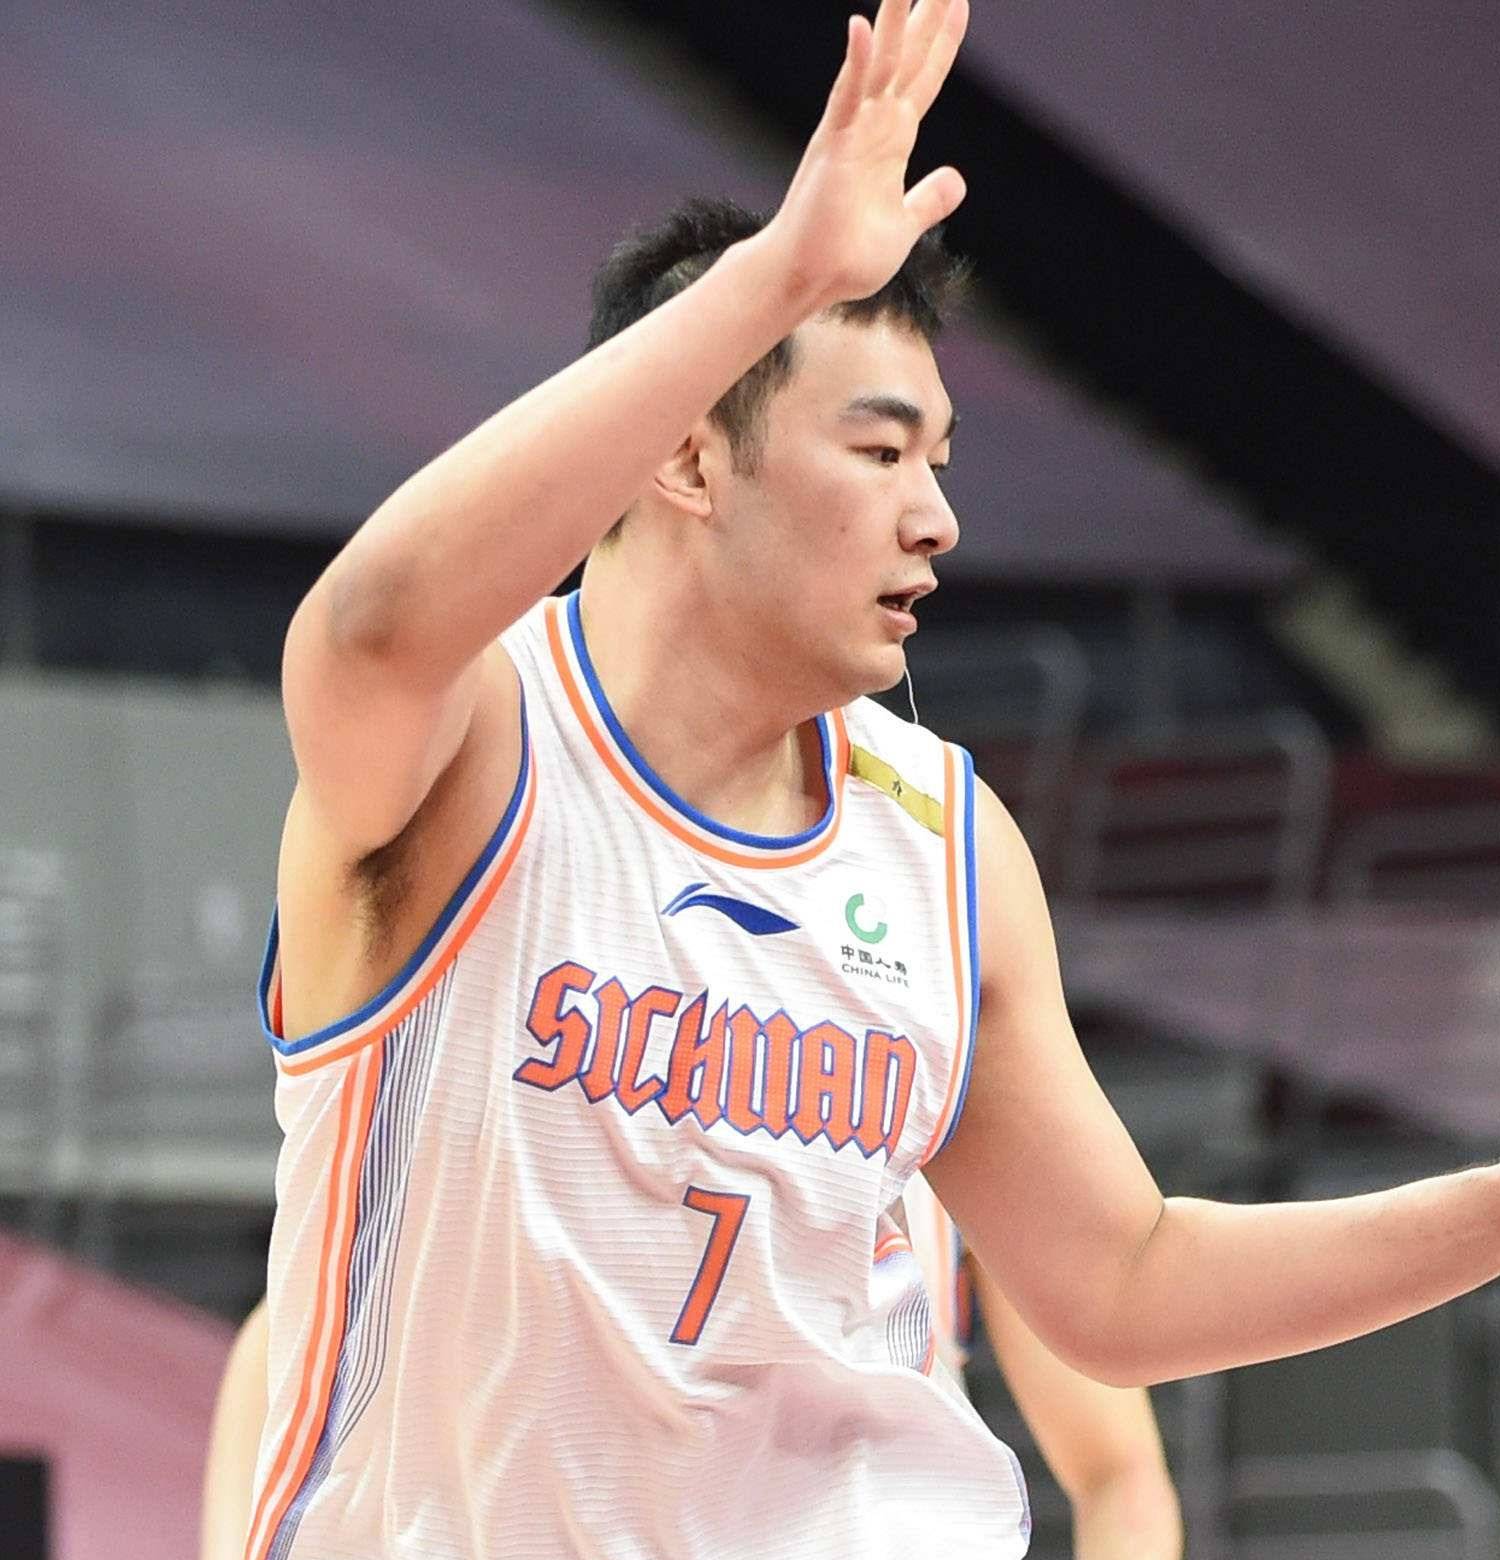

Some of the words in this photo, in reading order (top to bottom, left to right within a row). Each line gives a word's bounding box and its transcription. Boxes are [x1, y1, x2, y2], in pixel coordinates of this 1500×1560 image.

[841, 963, 881, 980] CHINA
[512, 960, 918, 1160] SICHUAN
[669, 1185, 751, 1347] 7
